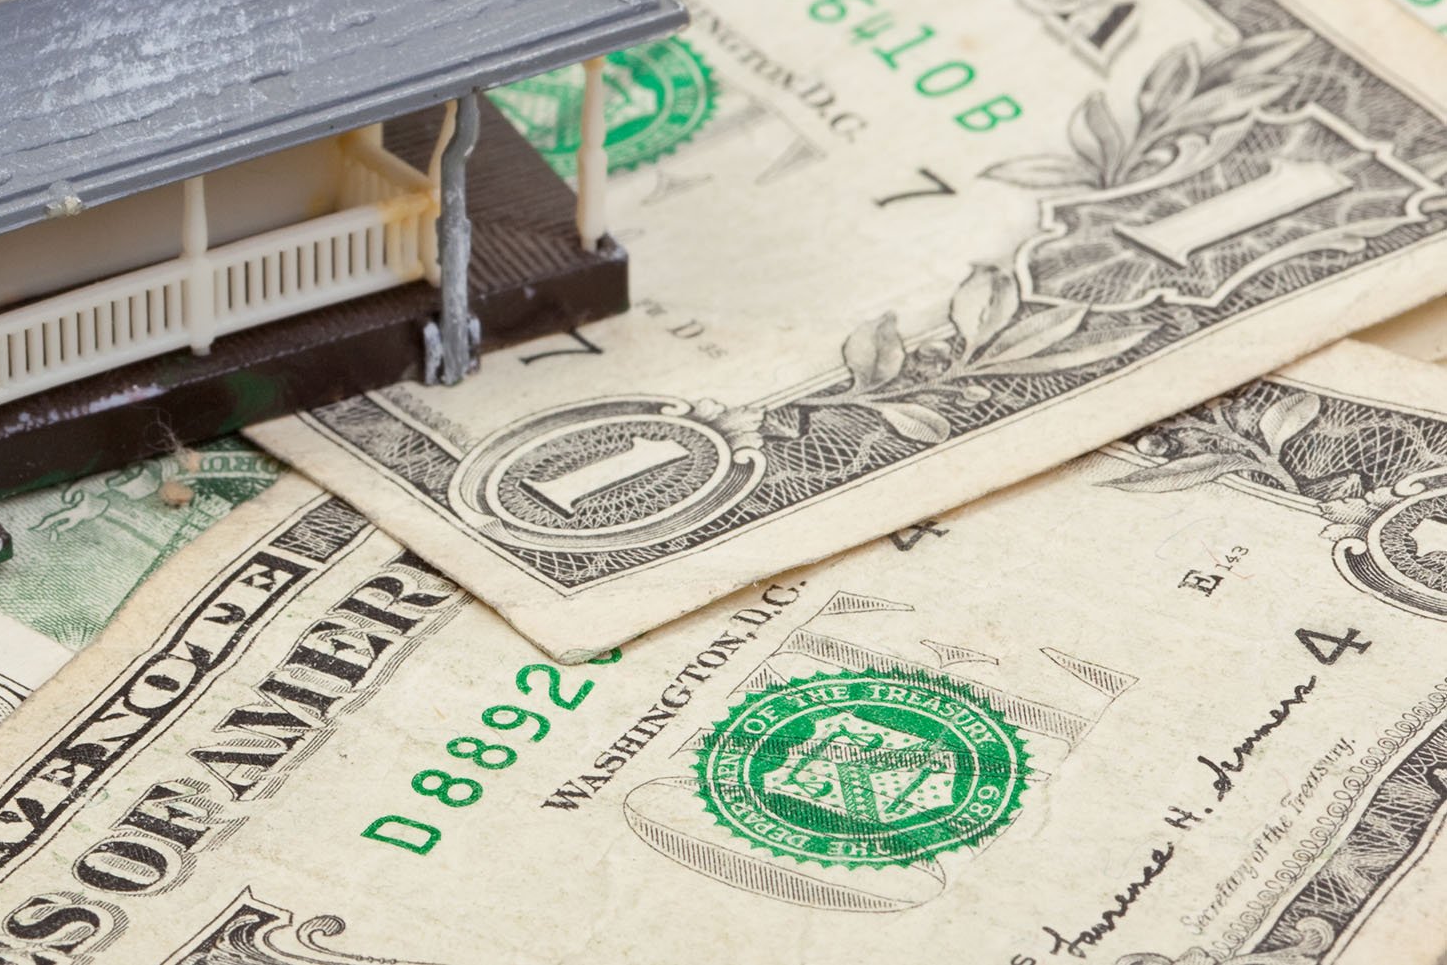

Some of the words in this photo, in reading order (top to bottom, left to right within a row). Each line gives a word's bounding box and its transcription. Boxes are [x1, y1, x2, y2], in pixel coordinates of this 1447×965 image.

[874, 168, 957, 208] 7
[1113, 158, 1355, 270] 1
[518, 327, 604, 366] 7
[515, 434, 692, 521] 1
[83, 559, 299, 758] NOTE
[1294, 627, 1374, 666] 4
[742, 704, 781, 736] OF
[785, 683, 852, 708] THE
[868, 685, 1002, 747] TREASURY
[73, 777, 247, 898] OF
[1178, 858, 1261, 938] Secretary
